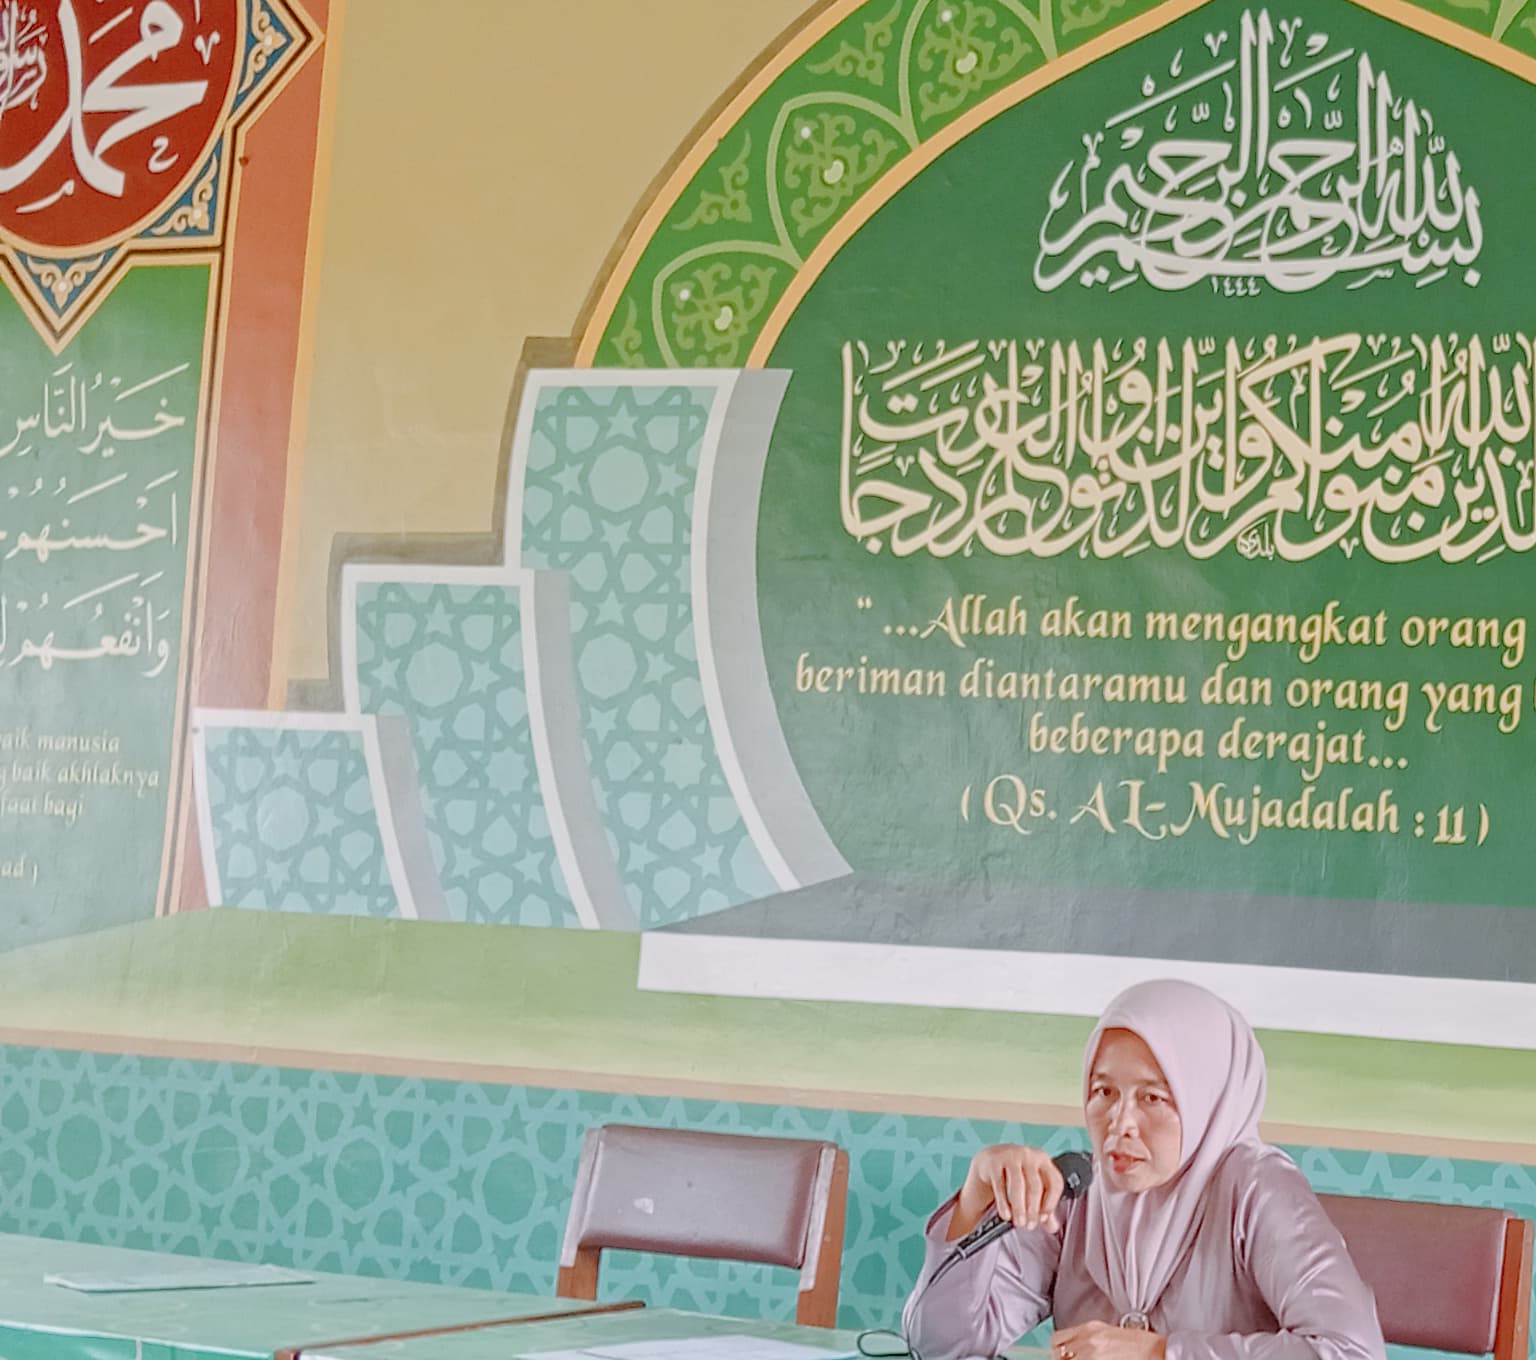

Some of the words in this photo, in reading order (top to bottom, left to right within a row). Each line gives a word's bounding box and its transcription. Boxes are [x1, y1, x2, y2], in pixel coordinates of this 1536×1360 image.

[1040, 596, 1132, 638] akan
[1145, 600, 1387, 663] mengangkat
[1400, 616, 1526, 668] orang
[796, 652, 945, 696] beriman
[959, 658, 1187, 703] diantaramu
[1200, 663, 1272, 706] dan
[1286, 677, 1408, 732] orang
[1422, 681, 1522, 733] yang
[38, 729, 120, 753] manusia
[1029, 712, 1204, 773] beberapa
